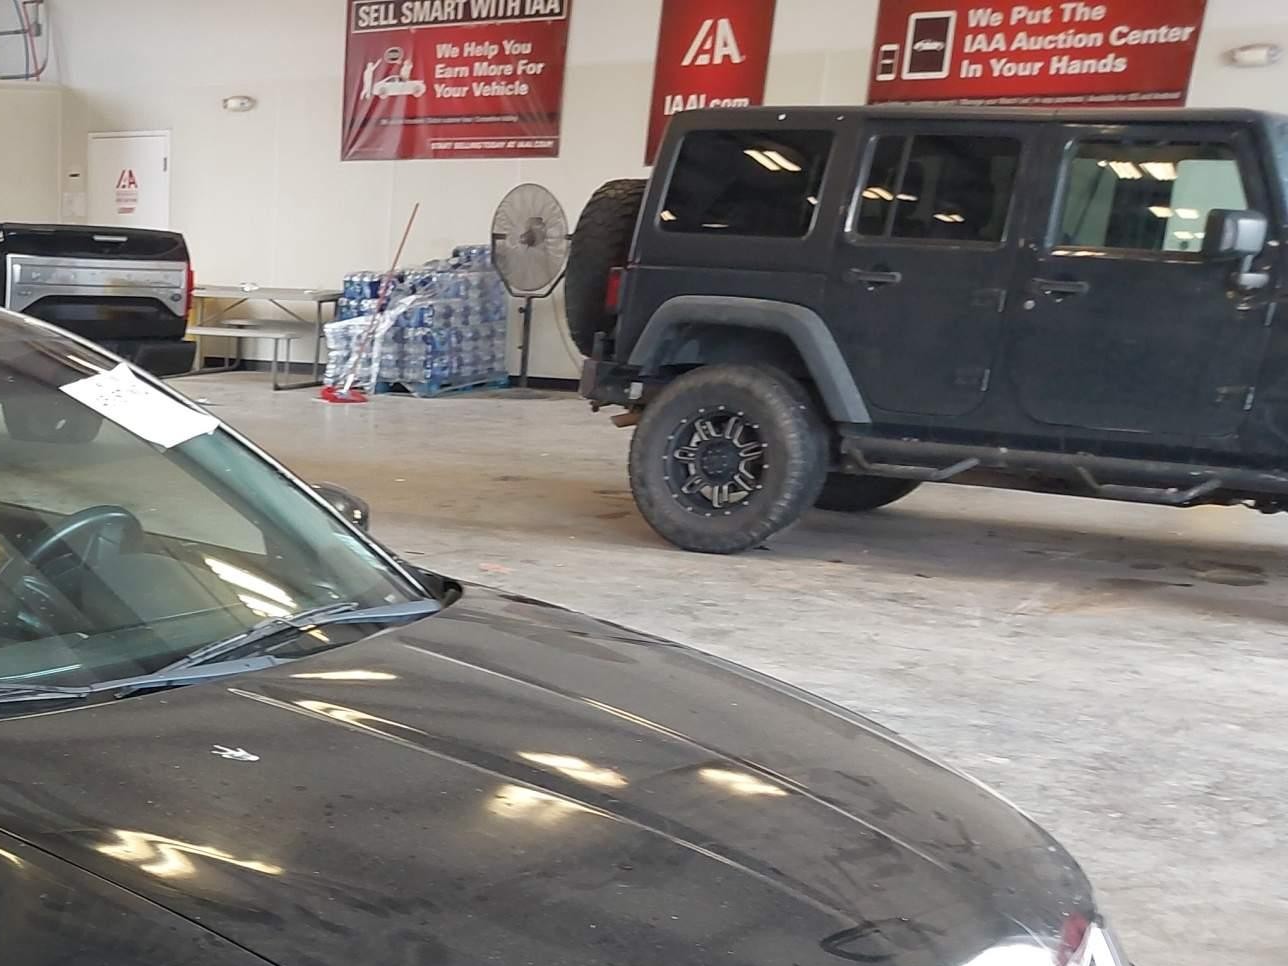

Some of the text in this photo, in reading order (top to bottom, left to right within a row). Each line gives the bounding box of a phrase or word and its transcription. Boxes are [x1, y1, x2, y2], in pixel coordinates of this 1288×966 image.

[358, 0, 561, 27] SELL SMART WITH IAA
[968, 2, 1107, 28] We Put The
[436, 40, 532, 59] We Help You
[963, 24, 1196, 53] IAA Auction Center
[434, 60, 545, 79] Earn More For
[960, 54, 1128, 79] In Your Hands
[434, 80, 529, 98] Your Vehicle
